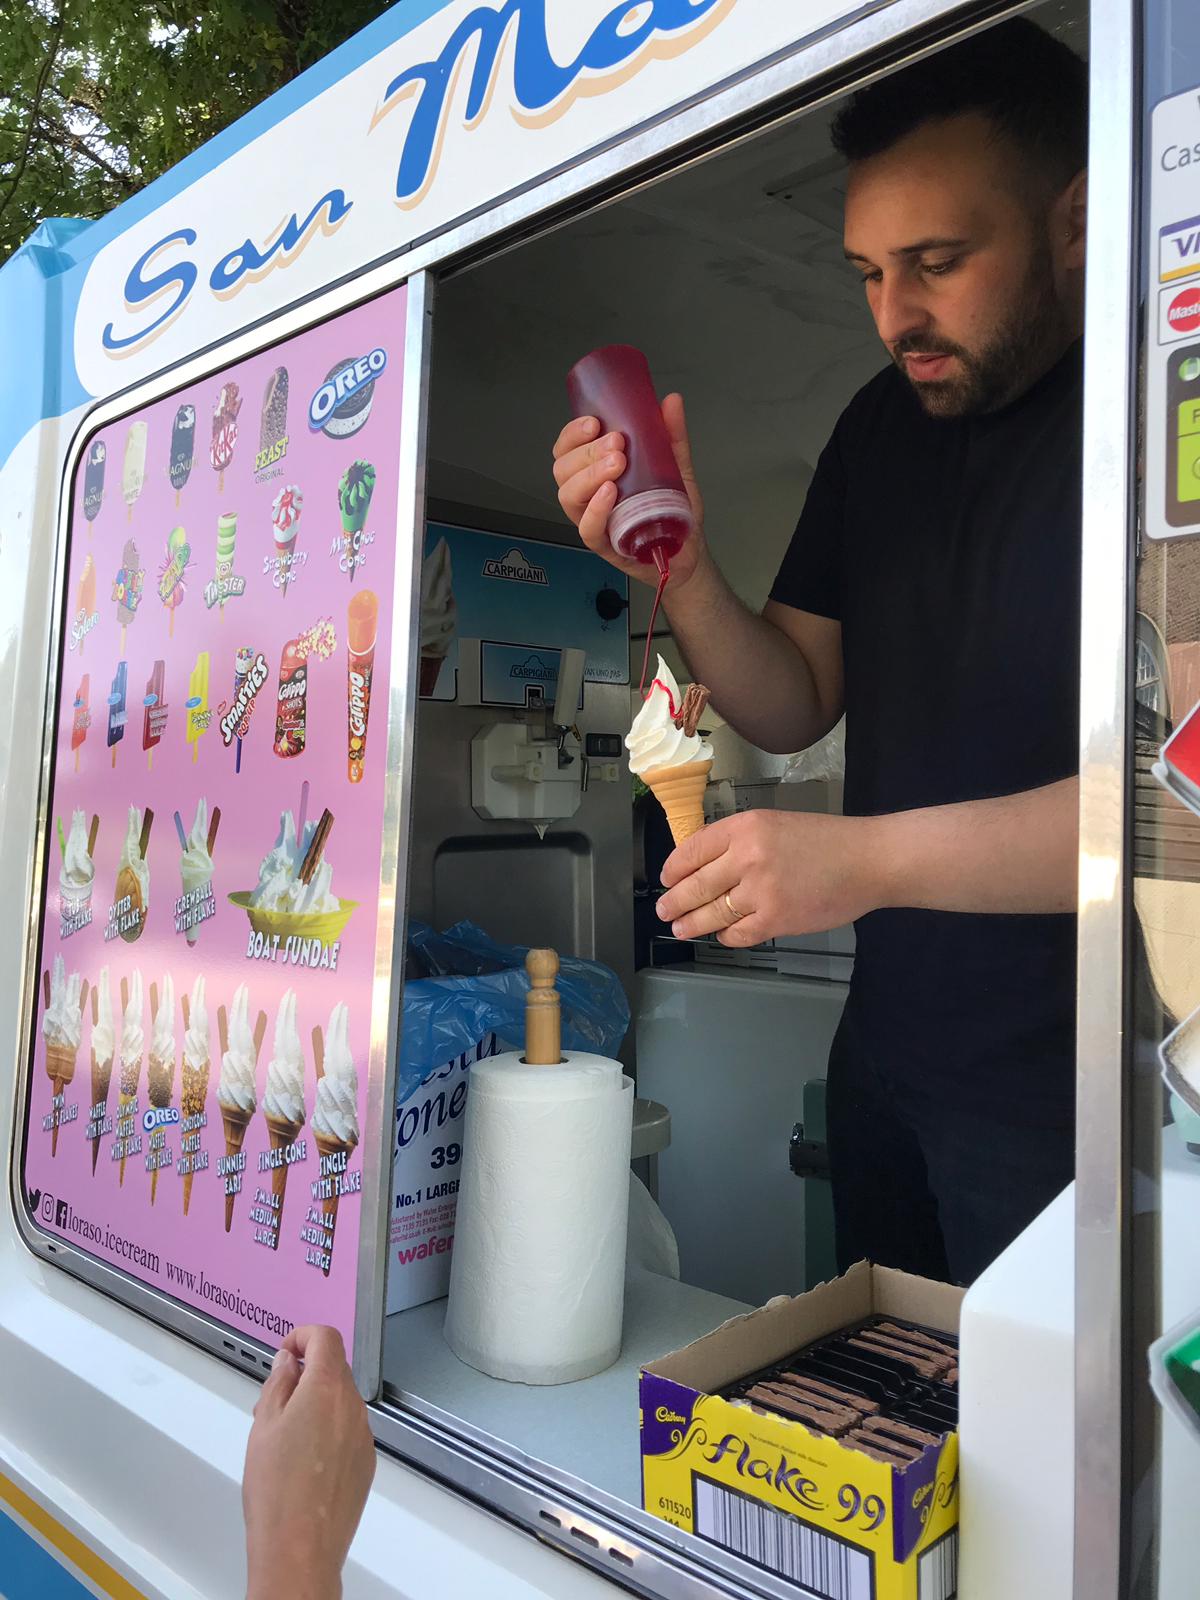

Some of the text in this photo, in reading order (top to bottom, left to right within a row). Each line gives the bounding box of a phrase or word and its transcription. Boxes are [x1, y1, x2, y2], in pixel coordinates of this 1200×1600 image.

[101, 189, 353, 354] San
[309, 348, 387, 424] OREO
[254, 436, 289, 474] FEAST
[255, 469, 285, 484] ORIGINAL
[263, 551, 308, 575] Strawberry
[339, 553, 367, 573] Cone
[487, 563, 543, 582] CARPIGIANI
[273, 570, 298, 588] Cone
[278, 680, 306, 701] Calippo
[350, 671, 366, 736] Calippo
[109, 895, 131, 921] OYSTER
[174, 881, 213, 917] SCREWBALL
[73, 908, 92, 933] FLAKE
[104, 908, 140, 942] WITH FLAKE
[174, 899, 216, 934] WITH FLAKE
[246, 931, 340, 970] BOAT SUNDAE
[143, 1107, 179, 1131] OREO
[397, 1081, 466, 1147] one
[216, 1152, 246, 1177] BUNNIES
[258, 1141, 307, 1173] SINGLE CONE
[319, 1151, 348, 1177] SINGLE
[431, 1143, 463, 1169] 39
[224, 1174, 242, 1195] EARS
[311, 1170, 361, 1200] WITH FLAKE
[254, 1188, 280, 1208] SMALL
[396, 1189, 421, 1208] No.1
[249, 1207, 278, 1228] MEDIUM
[305, 1206, 334, 1229] SMALL
[68, 1207, 160, 1273] loraso.icecream
[253, 1227, 276, 1248] LARGE
[300, 1225, 332, 1249] MEDIUM
[305, 1247, 331, 1270] LARGE
[398, 1235, 454, 1265] wafer
[656, 1406, 686, 1424] Cadbury
[702, 1433, 825, 1511] flake
[834, 1483, 886, 1531] 99
[659, 1497, 691, 1519] 611520
